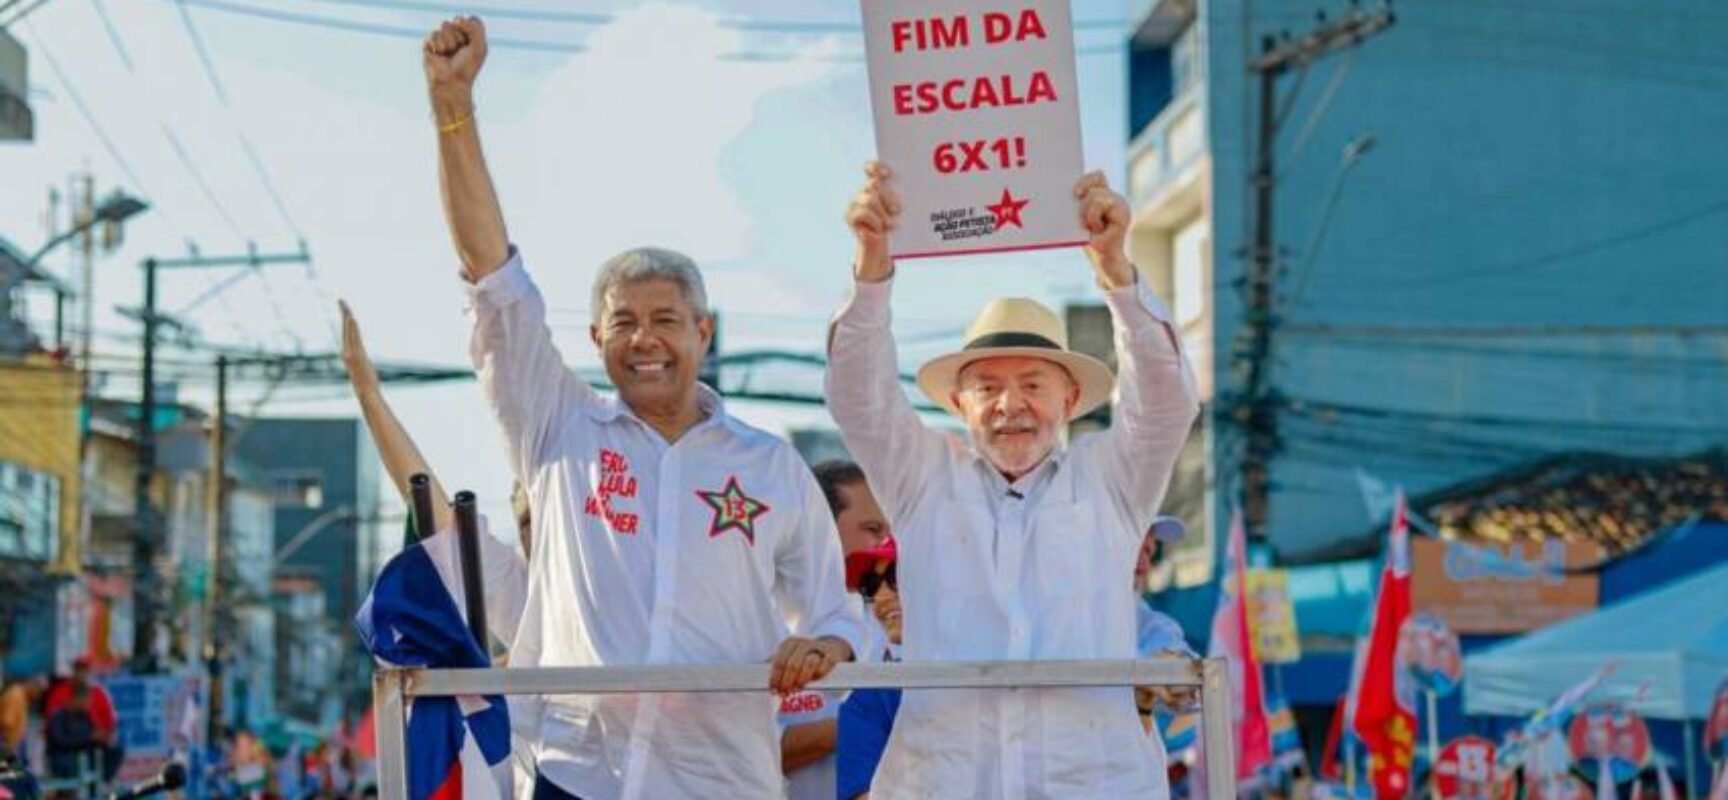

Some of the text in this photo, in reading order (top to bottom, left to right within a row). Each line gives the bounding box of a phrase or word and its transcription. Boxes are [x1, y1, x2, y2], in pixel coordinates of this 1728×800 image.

[891, 9, 1047, 53] FIM DA
[893, 71, 1058, 116] ESCALA
[933, 136, 1027, 174] 6X1!
[725, 499, 748, 519] 13
